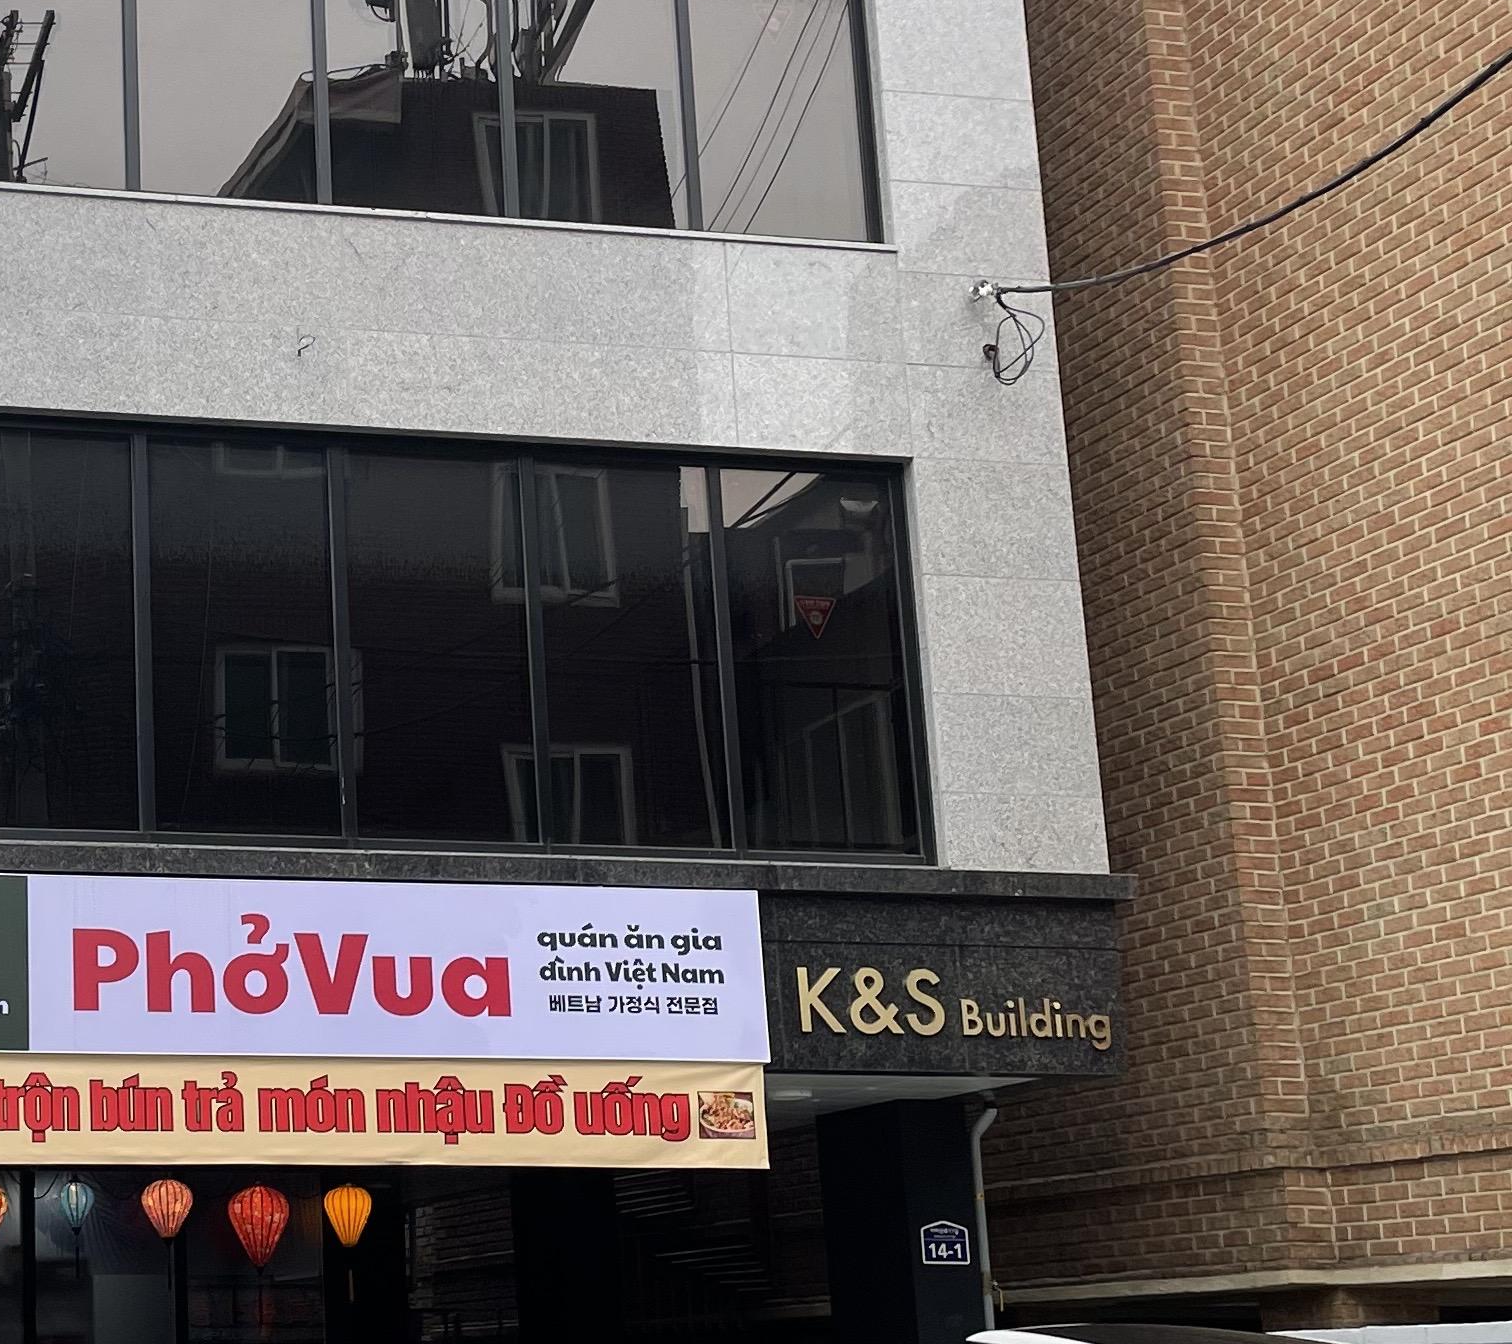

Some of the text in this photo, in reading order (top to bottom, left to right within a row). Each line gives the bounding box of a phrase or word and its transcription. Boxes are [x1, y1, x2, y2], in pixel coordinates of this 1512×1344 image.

[537, 922, 722, 956] quán ăn gia
[605, 958, 657, 990] Việt
[661, 962, 725, 984] Nam
[548, 994, 719, 1015] 베트남 가정식 전문점
[795, 966, 1112, 1051] K&S Building
[89, 1073, 174, 1132] bún
[181, 1071, 245, 1132] trả
[257, 1074, 366, 1134] món
[376, 1075, 496, 1145] nhậu
[502, 1074, 568, 1134] Đồ
[573, 1075, 691, 1142] uống
[928, 1242, 962, 1259] 14-1
